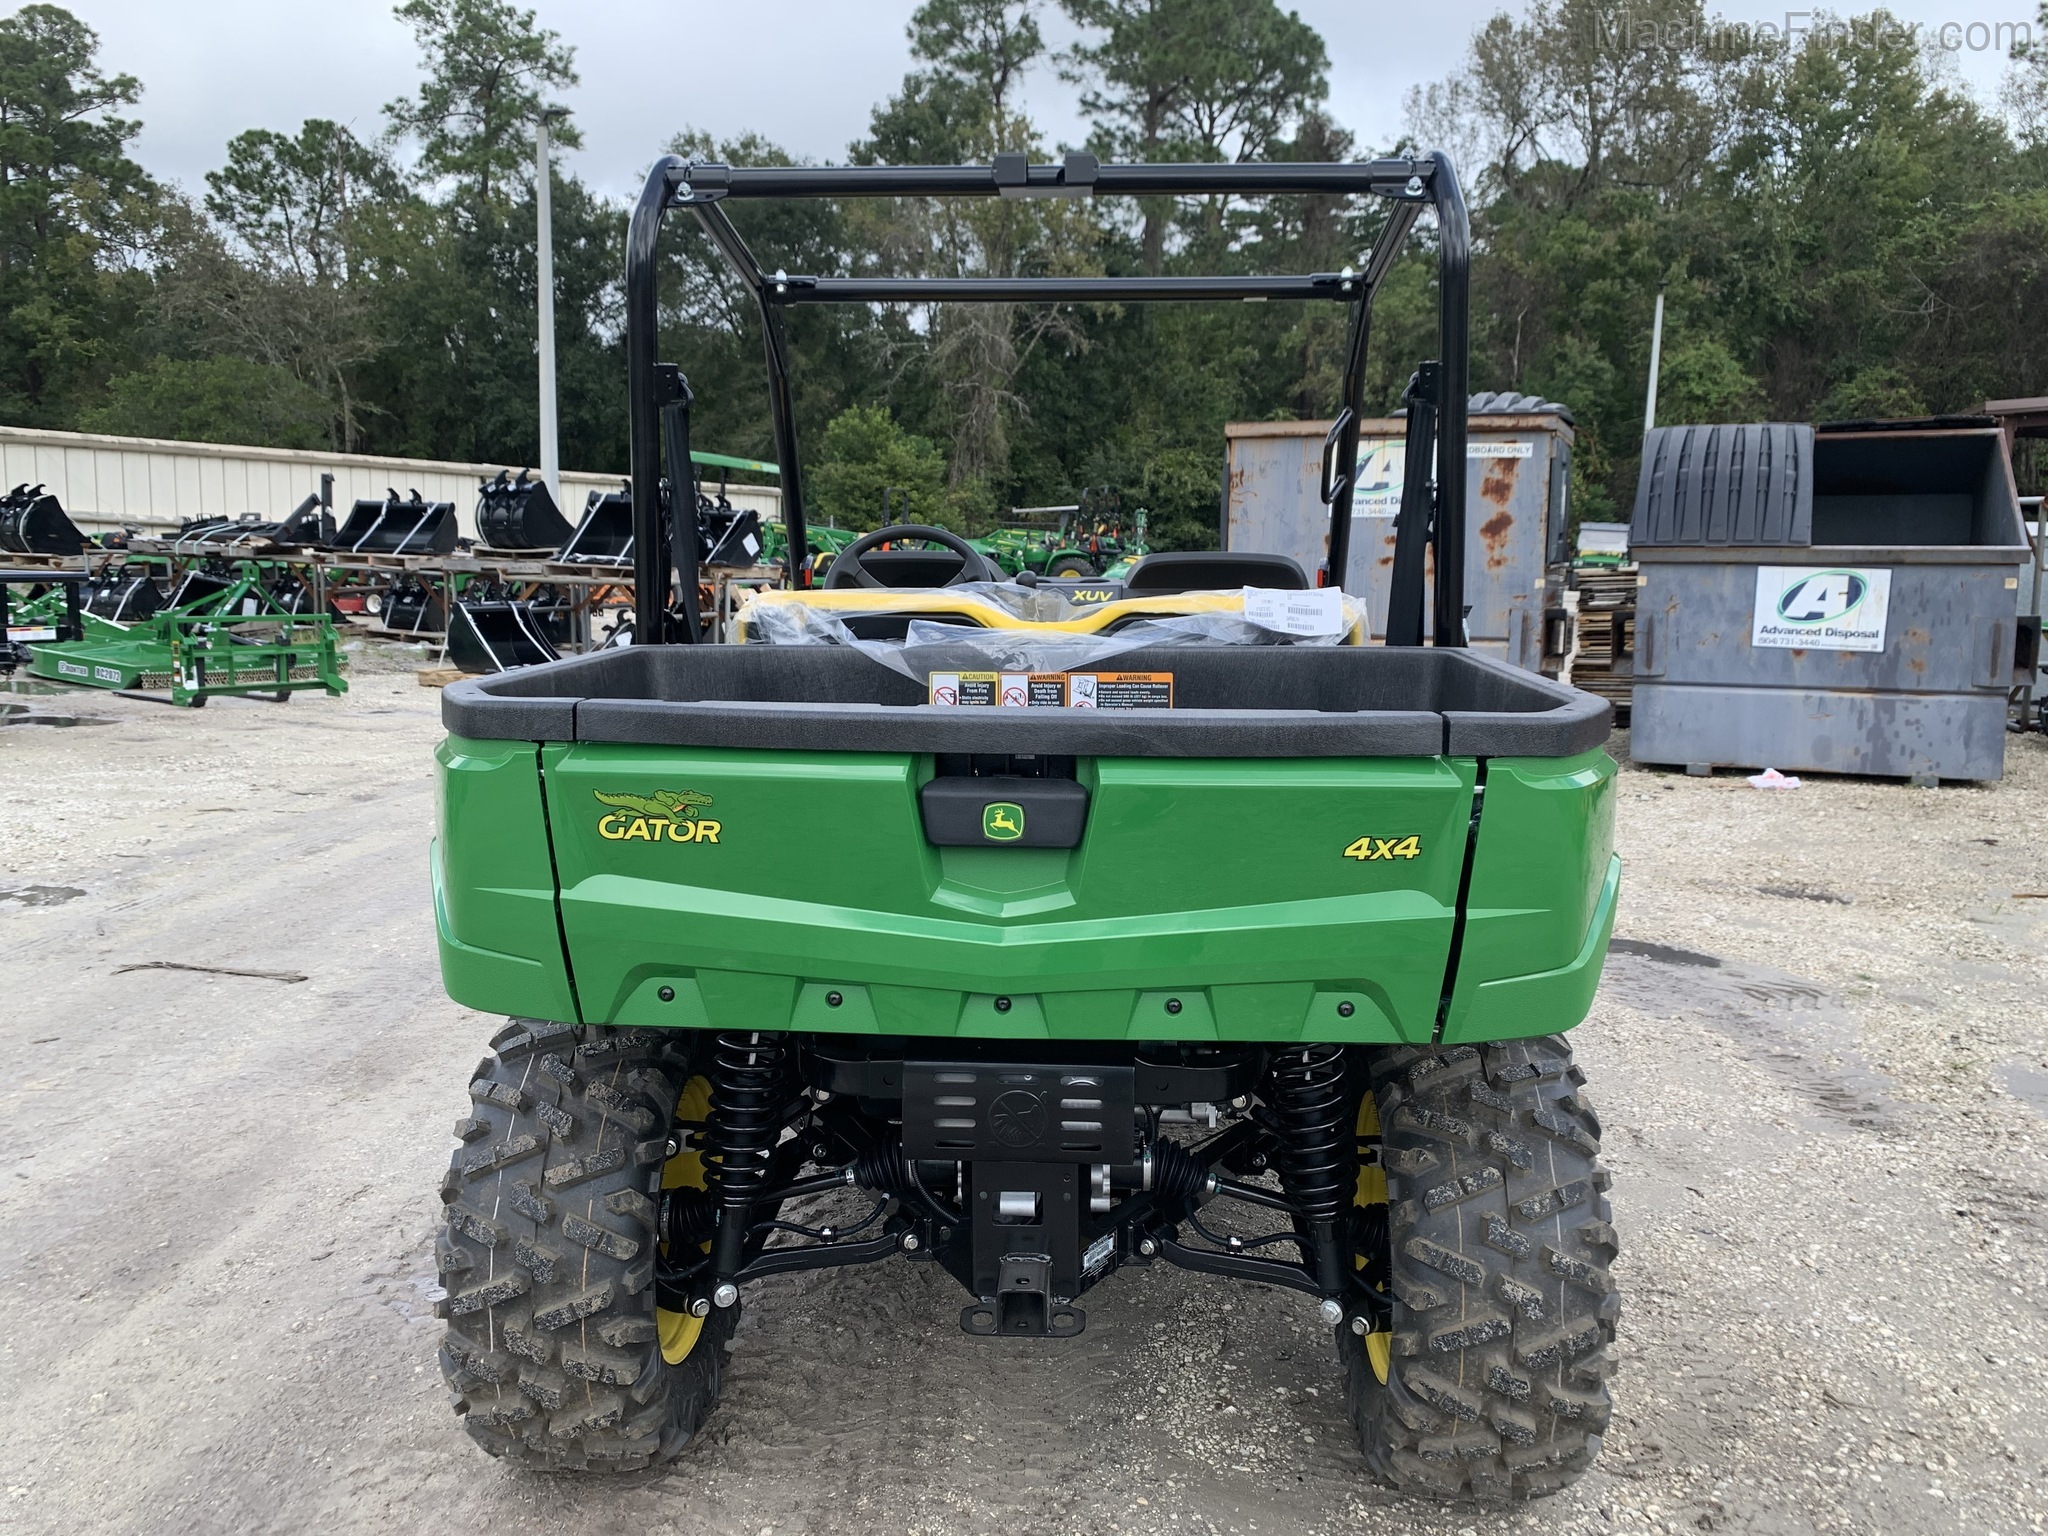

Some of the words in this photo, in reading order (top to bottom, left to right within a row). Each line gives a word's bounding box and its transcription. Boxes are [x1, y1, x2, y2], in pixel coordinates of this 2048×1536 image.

[1468, 446, 1504, 454] DBOARD
[1507, 446, 1531, 454] ONLY
[1071, 590, 1114, 602] XUV
[1760, 625, 1822, 637] Advanced
[1824, 628, 1880, 640] Disposal
[1758, 637, 1778, 645] (904)
[1779, 638, 1820, 647] 731-3440
[60, 661, 88, 676] FRONTIER
[96, 666, 120, 682] RC2072
[597, 813, 721, 844] GATOR
